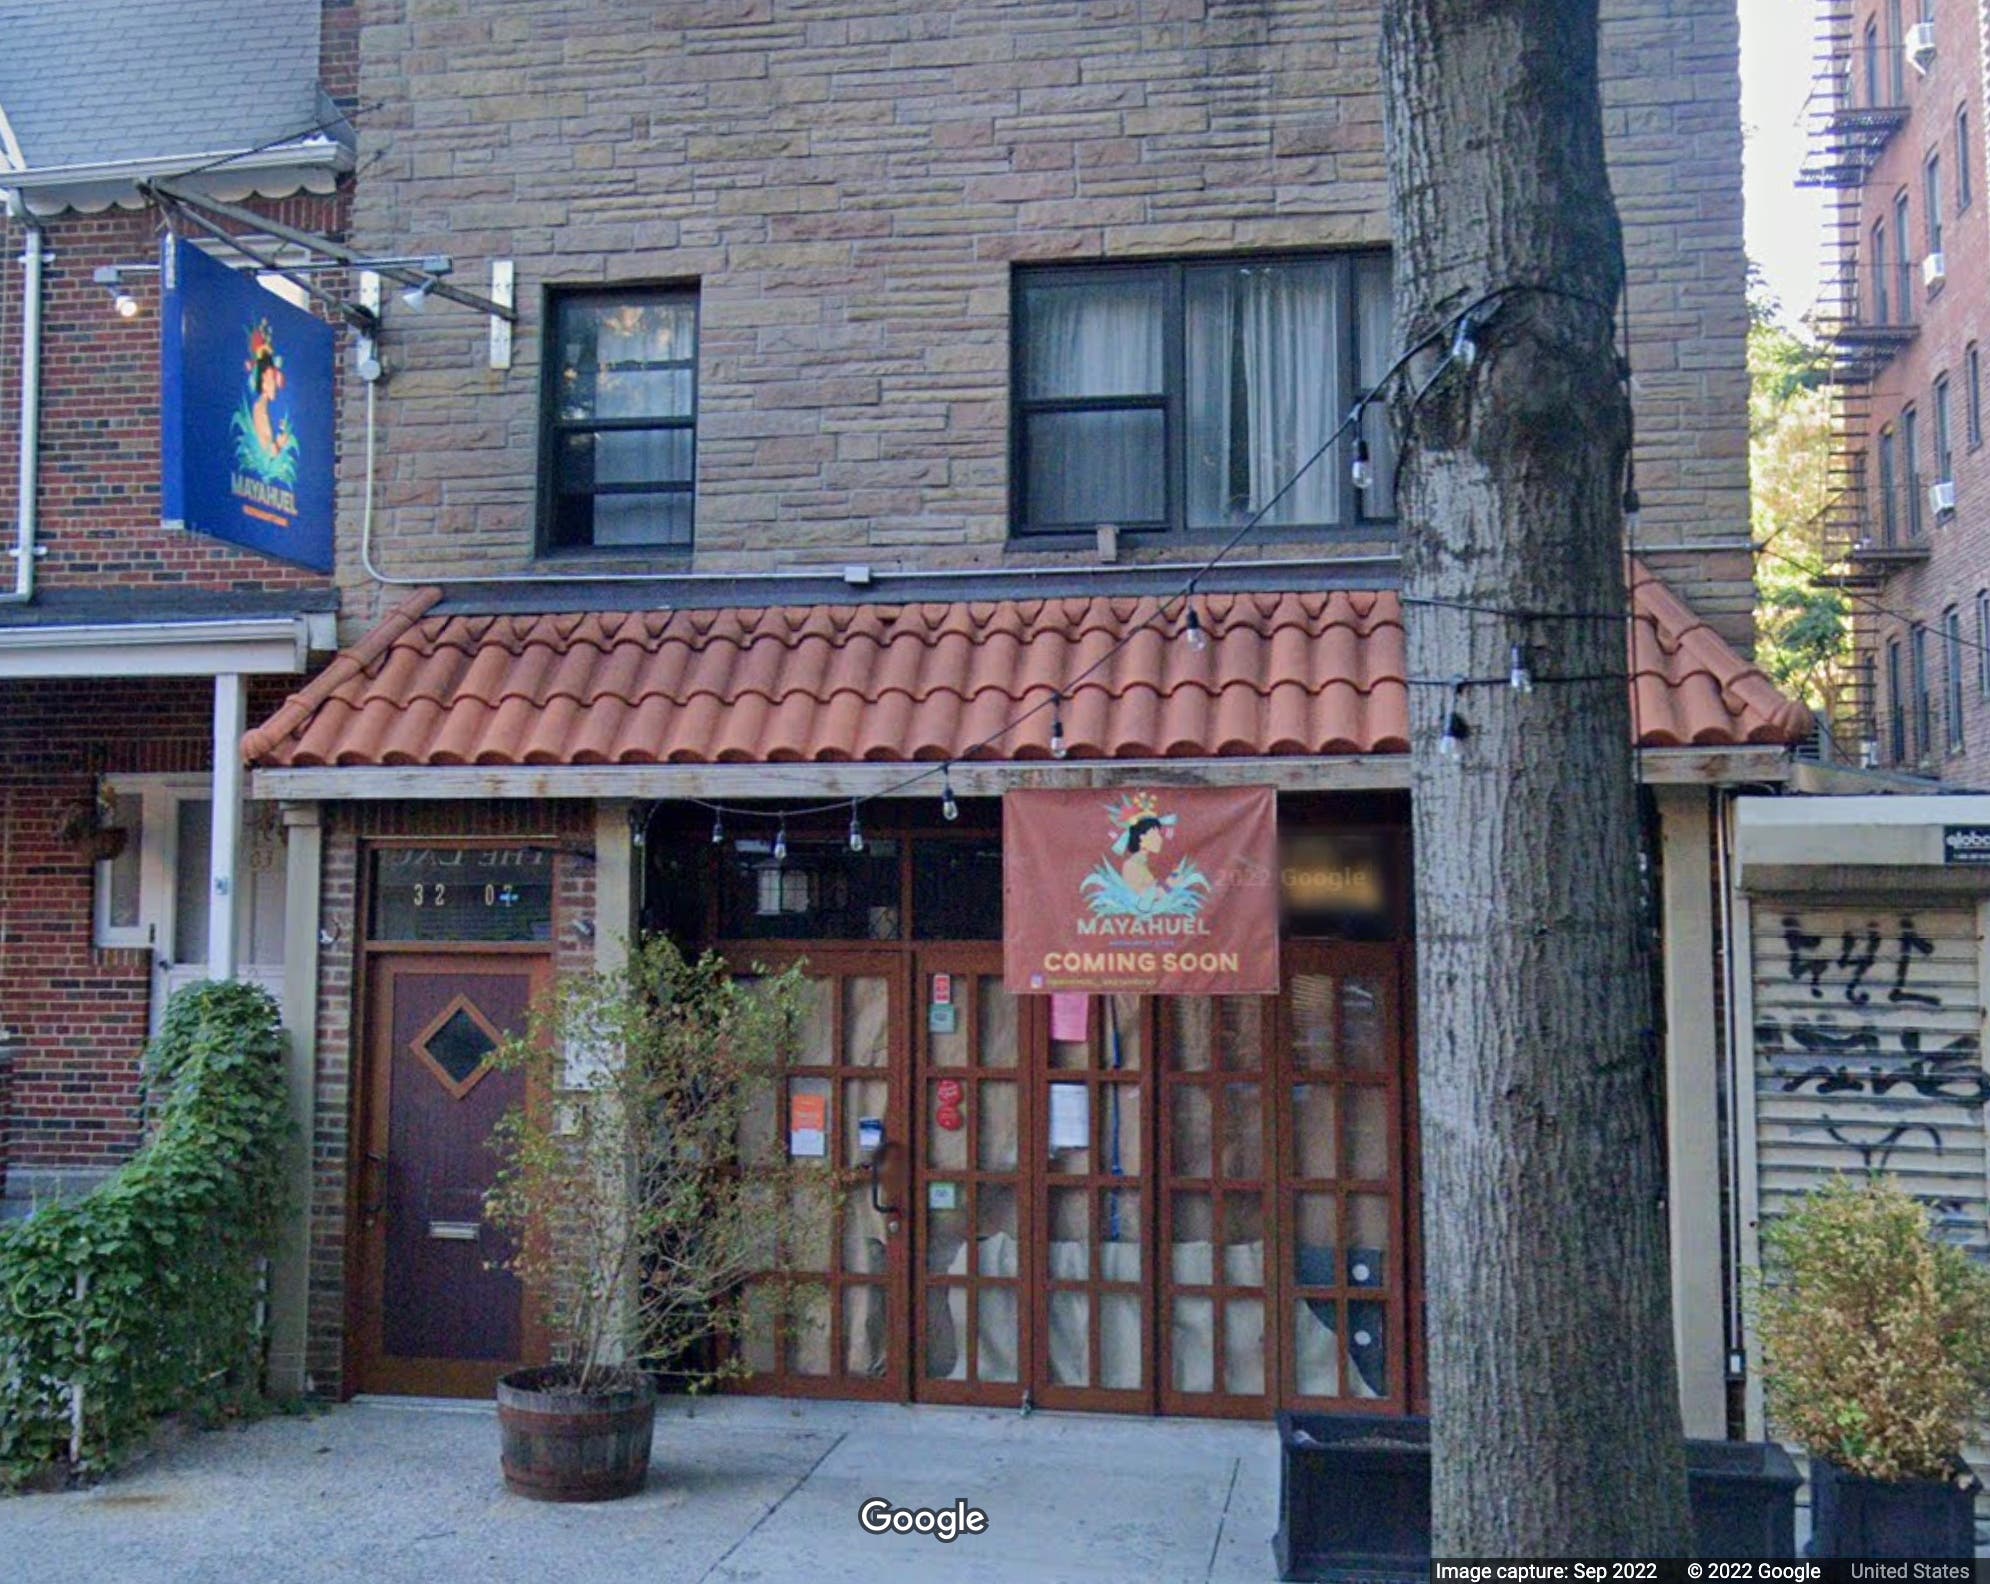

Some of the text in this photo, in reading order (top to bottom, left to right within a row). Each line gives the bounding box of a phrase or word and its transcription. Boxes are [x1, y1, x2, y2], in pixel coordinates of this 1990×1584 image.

[231, 472, 299, 516] MAYAHUEL
[413, 883, 446, 906] 32
[1077, 918, 1210, 935] MAYAHUEL
[1043, 952, 1239, 972] COMING SOON
